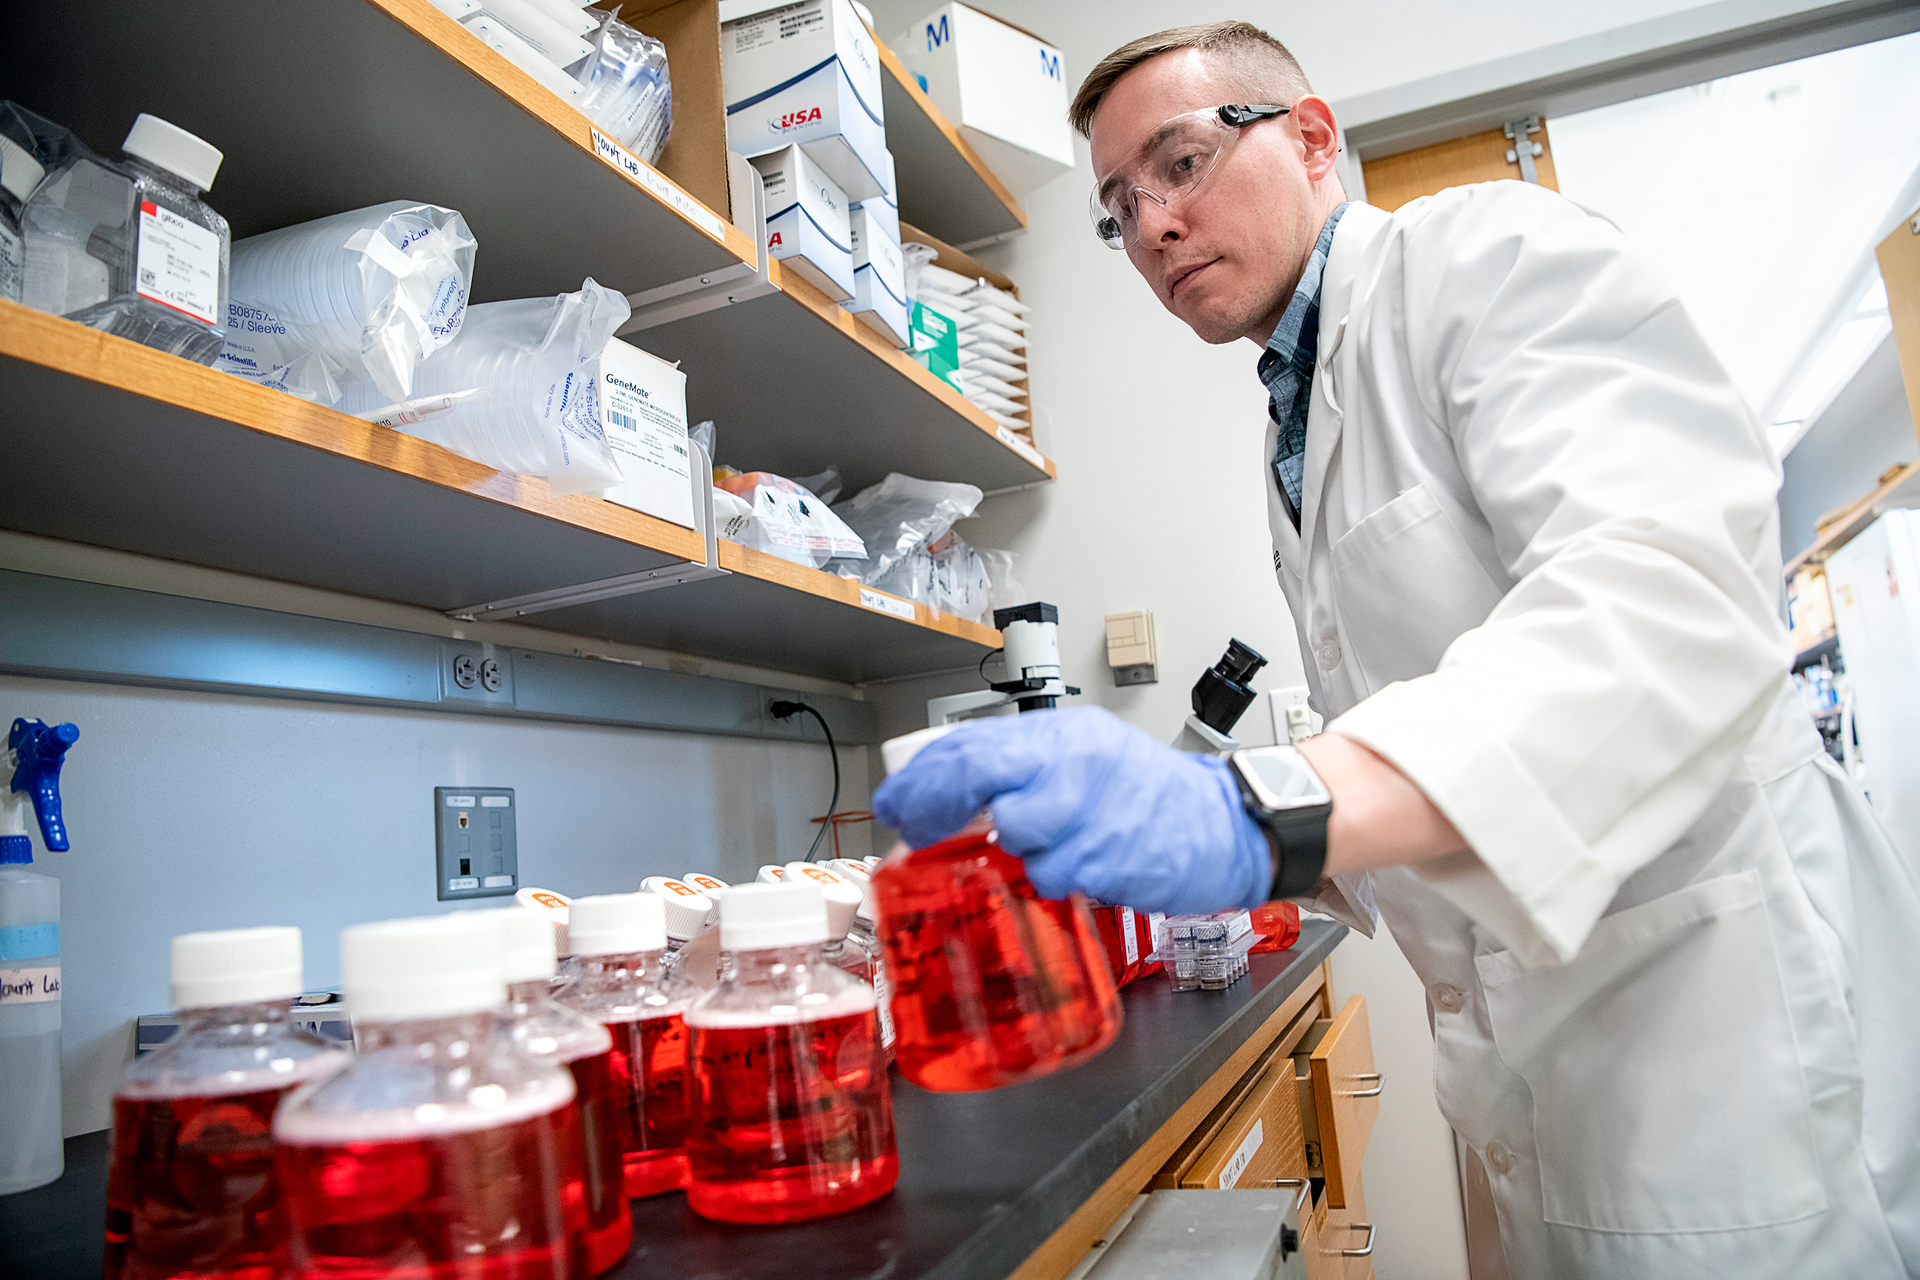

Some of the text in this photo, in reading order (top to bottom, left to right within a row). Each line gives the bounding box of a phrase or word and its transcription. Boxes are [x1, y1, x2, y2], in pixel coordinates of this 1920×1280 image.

[781, 107, 823, 128] USA
[624, 157, 639, 175] LAB
[161, 213, 184, 229] gibco
[227, 316, 239, 329] 25
[247, 320, 286, 335] Sleeve
[226, 353, 258, 368] Scientific
[605, 373, 649, 399] GeneMate
[0, 974, 60, 999] ount Lab
